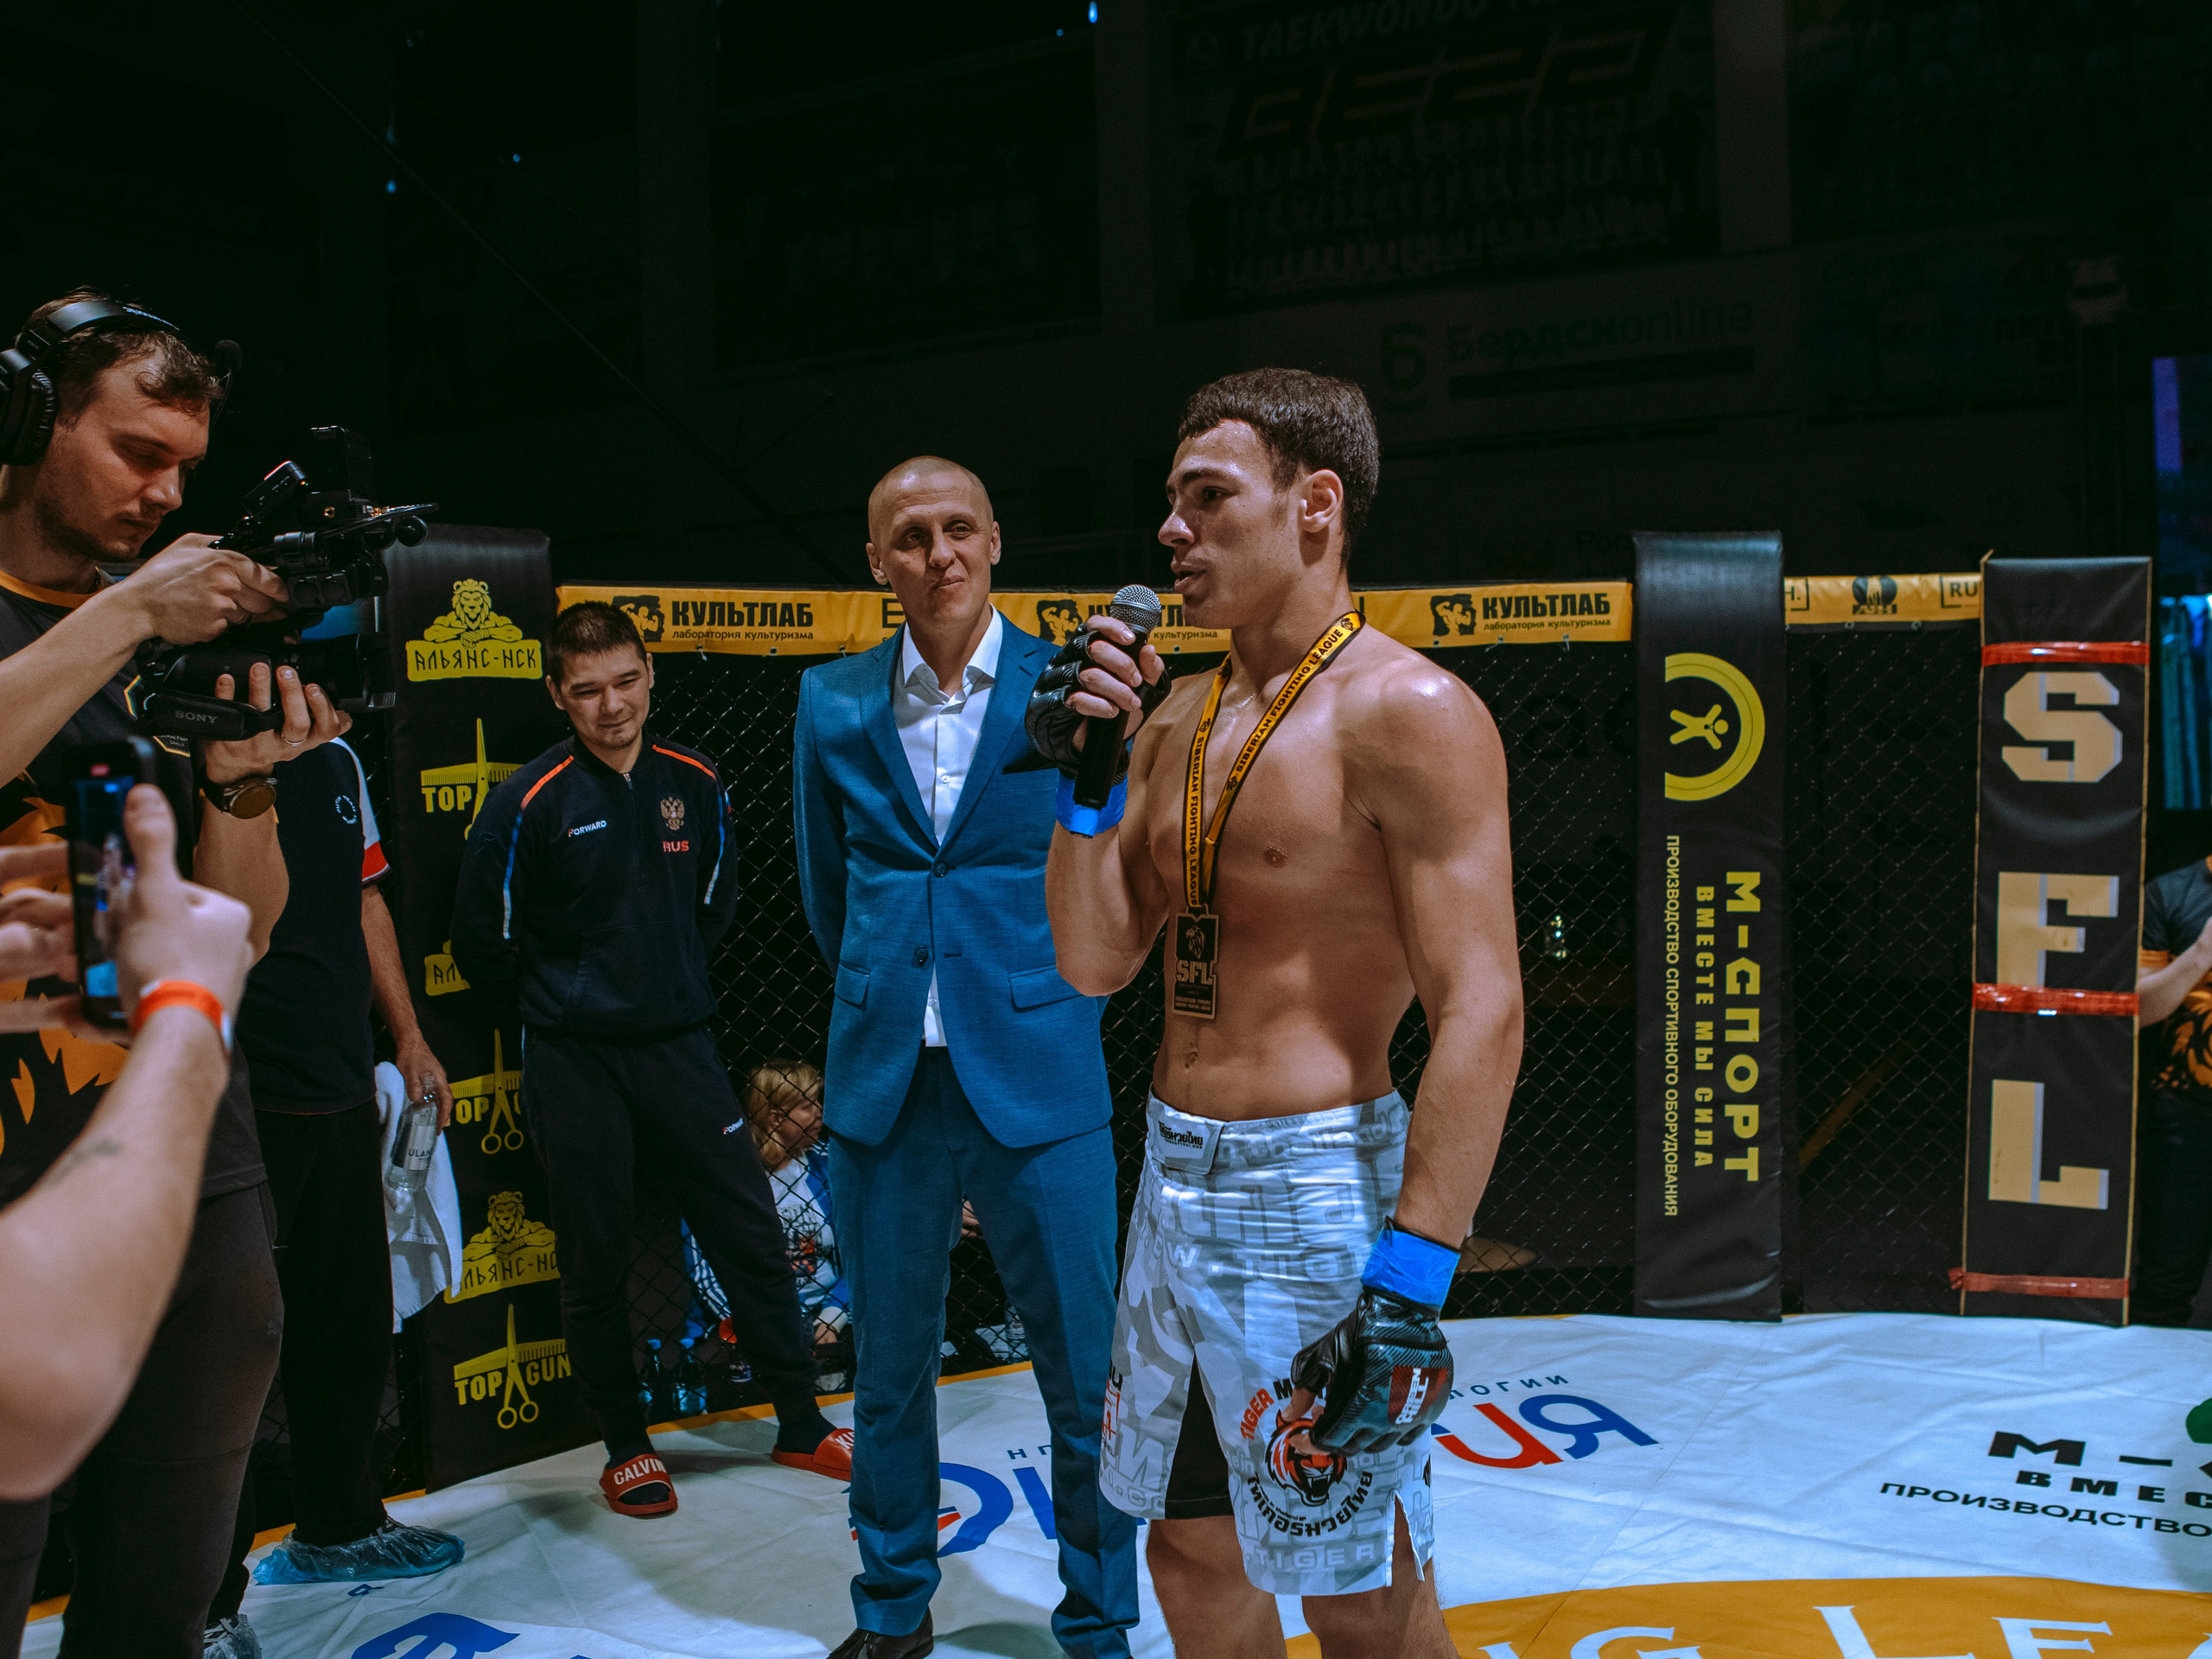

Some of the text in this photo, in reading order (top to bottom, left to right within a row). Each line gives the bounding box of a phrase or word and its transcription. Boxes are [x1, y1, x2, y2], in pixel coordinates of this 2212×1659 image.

[671, 601, 814, 627] КУЛЬТЛАБ
[1483, 593, 1611, 620] КУЛЬТЛАБ
[672, 629, 813, 642] лаборатория культуризма
[1154, 631, 1217, 640] культуризма
[1484, 619, 1611, 632] лаборатория культуризма
[415, 648, 537, 671] АЛЬЯНС-НСК
[1236, 628, 1344, 772] SIBERIAN FIGHTING LEAGUE
[175, 709, 218, 723] SONY
[421, 785, 472, 813] TOP
[568, 819, 607, 838] FORWARD
[1188, 736, 1205, 906] SIBERIAN FIGHTING LEAGUE
[663, 840, 690, 853] RUS
[1176, 959, 1213, 985] SFL
[1662, 835, 1680, 1217] ПРОИЗВОДСТВО СПОРТИВНОГО ОБОРУДОВАНИЯ
[1694, 886, 1715, 1168] ВМЕСТЕ МЫ СИЛА
[445, 1095, 490, 1126] OP
[464, 1250, 559, 1289] ЛЬЯНС-НС
[454, 1353, 572, 1406] TOP GUN
[1240, 1388, 1274, 1440] TIGER
[2015, 1470, 2212, 1510] ВМЕС
[1879, 1482, 2212, 1538] ПРОИЗВОДСТВО
